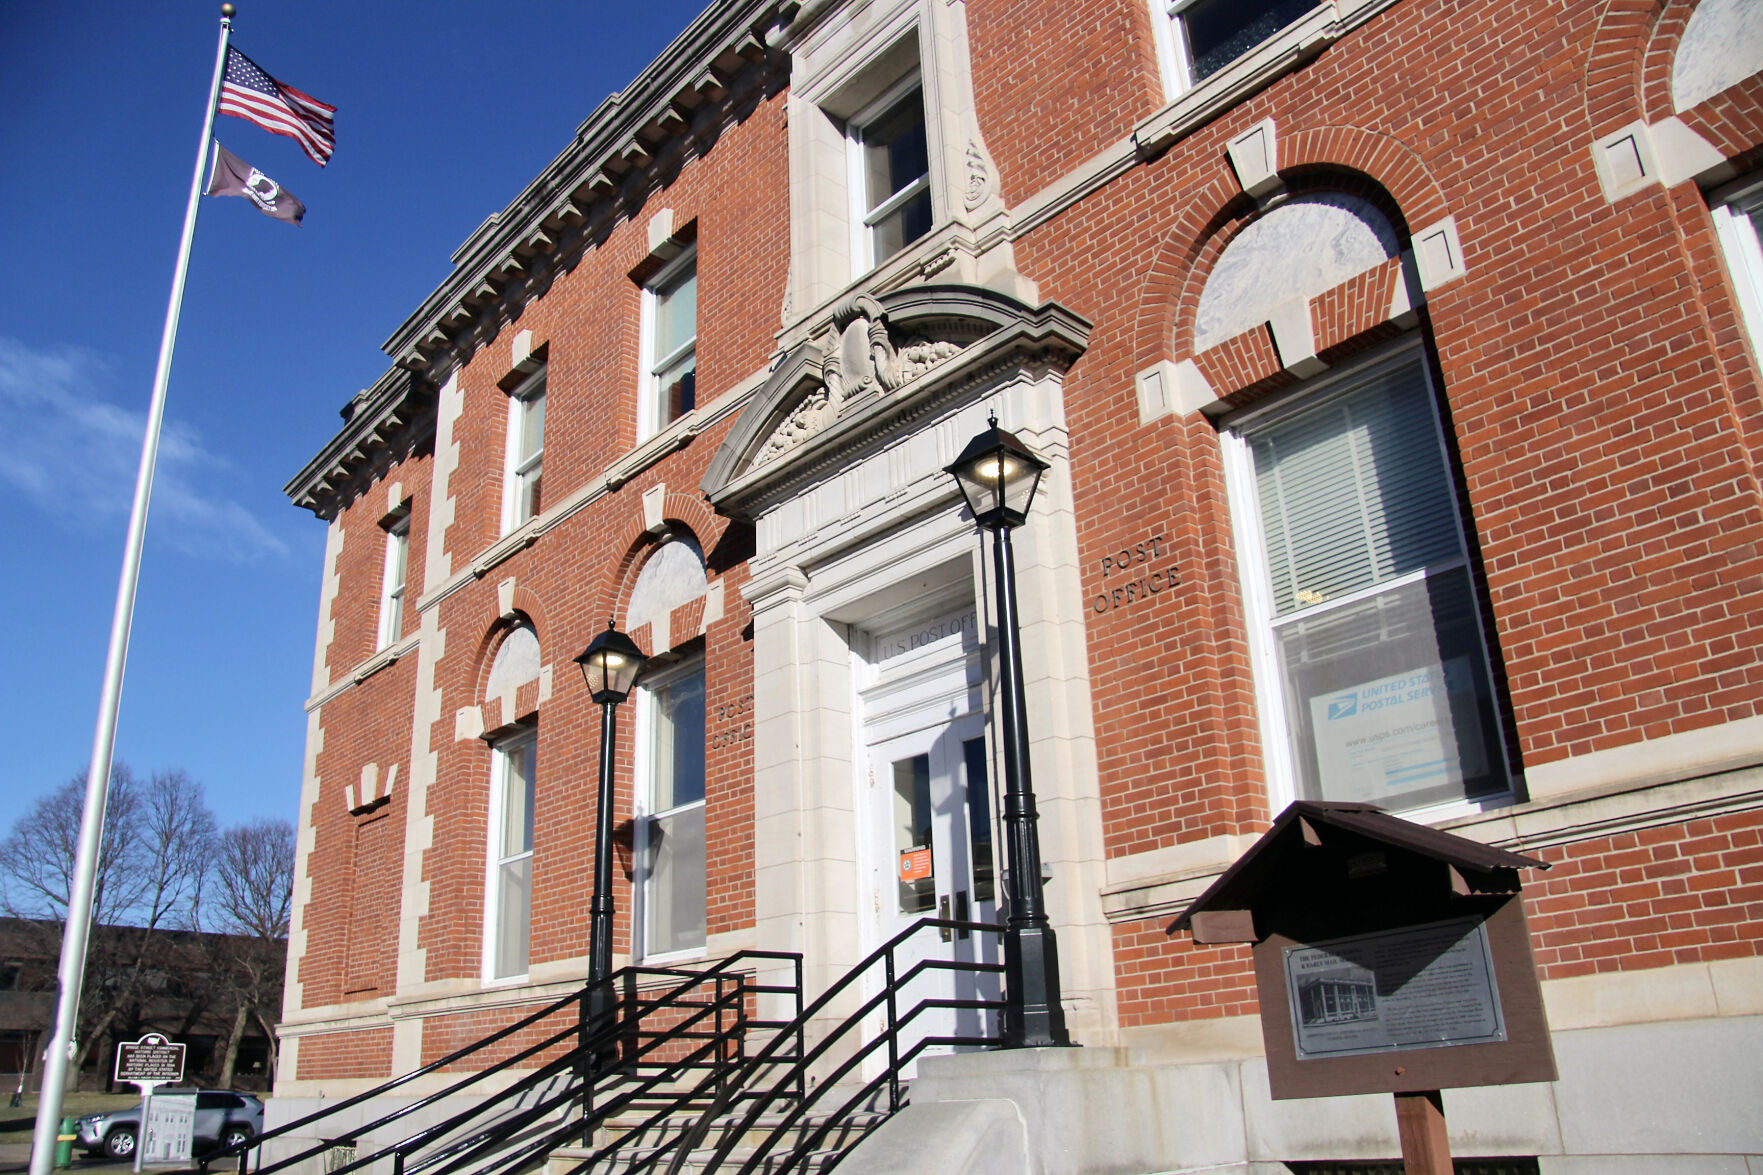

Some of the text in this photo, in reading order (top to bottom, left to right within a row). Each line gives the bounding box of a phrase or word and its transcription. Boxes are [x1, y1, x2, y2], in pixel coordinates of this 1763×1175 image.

[1102, 536, 1163, 577] POST
[1095, 567, 1182, 613] OFFICE
[910, 623, 945, 650] POST
[950, 611, 977, 634] OFF
[1362, 679, 1406, 699] UNITED
[719, 695, 755, 722] POST
[1362, 694, 1404, 712] POSTAL
[712, 724, 753, 750] OFFIC
